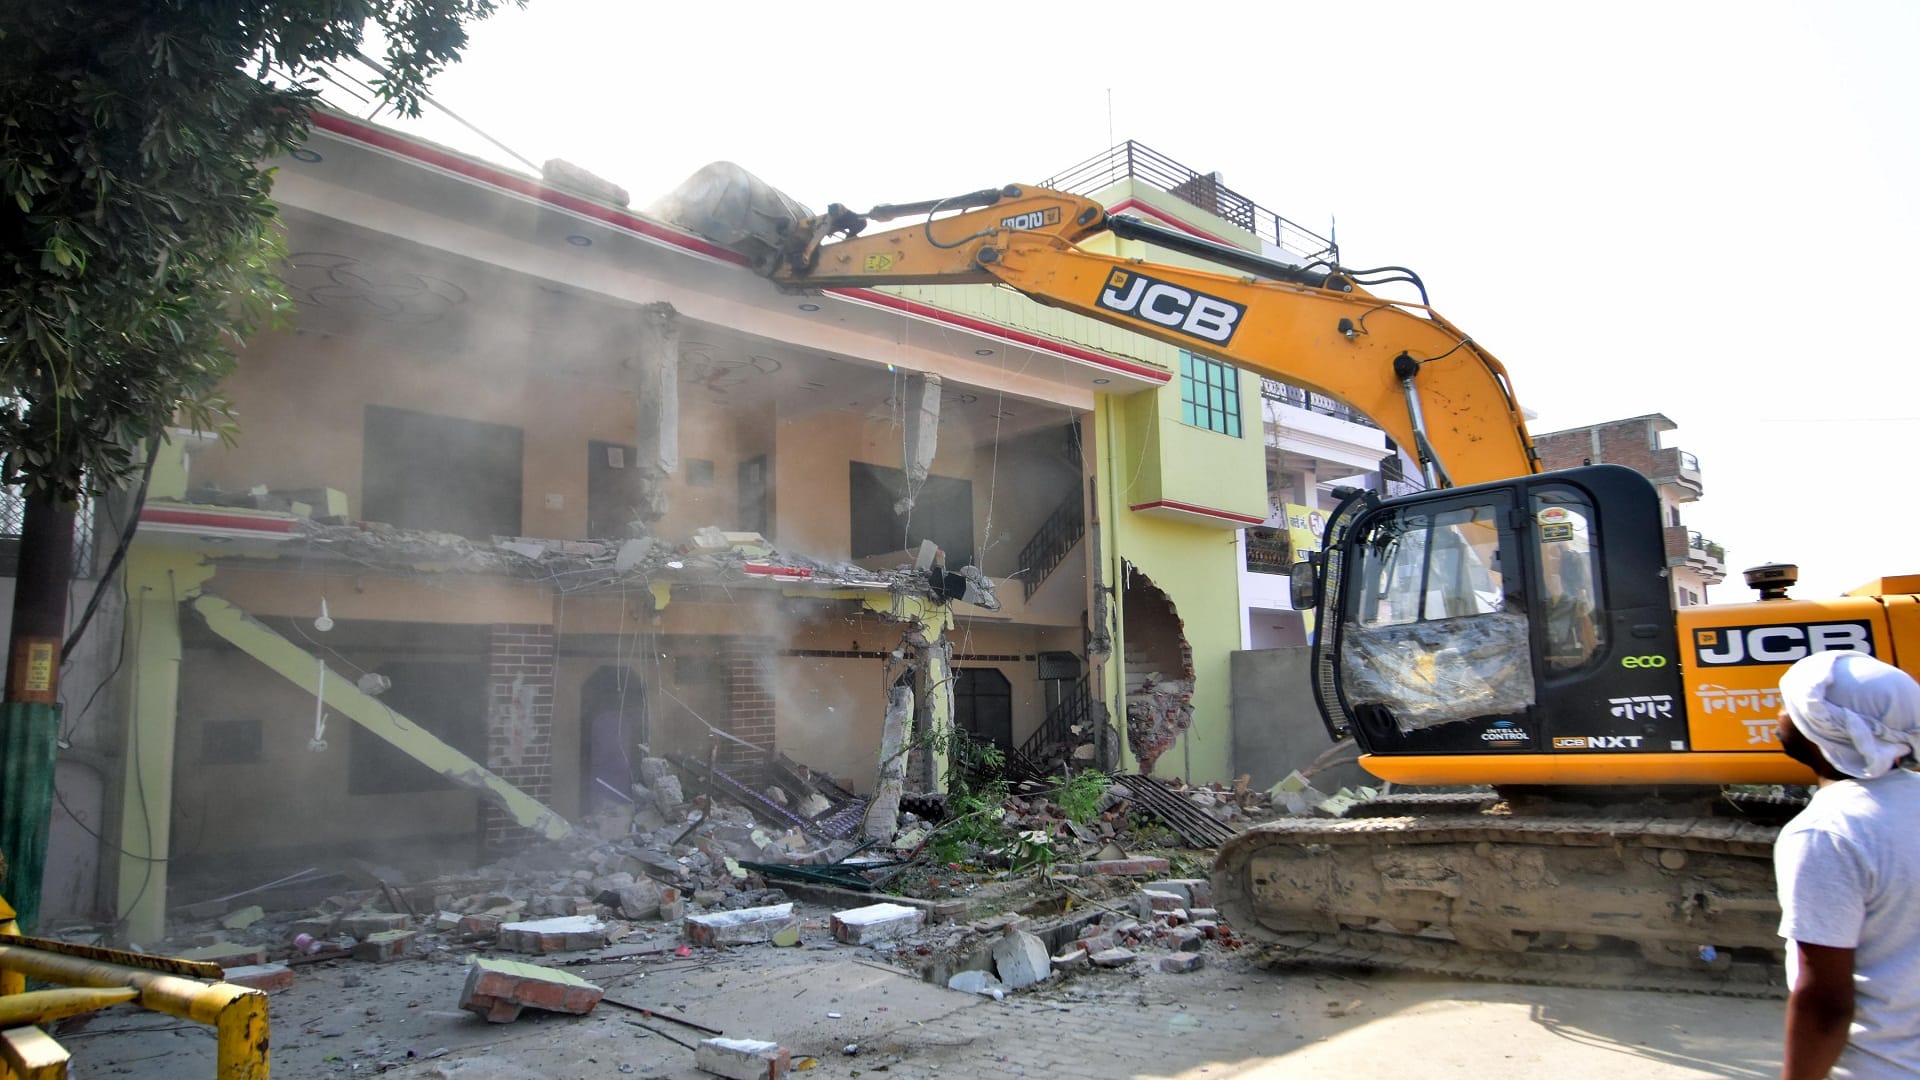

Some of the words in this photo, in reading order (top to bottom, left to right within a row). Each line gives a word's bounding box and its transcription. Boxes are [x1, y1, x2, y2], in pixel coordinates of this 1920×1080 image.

[1102, 277, 1239, 341] JCB
[1699, 623, 1872, 664] JCB
[1621, 655, 1667, 669] eco
[1608, 695, 1673, 720] नगर
[1481, 732, 1530, 741] CONTROL
[1556, 739, 1585, 747] JCB
[1587, 735, 1644, 748] NXT
